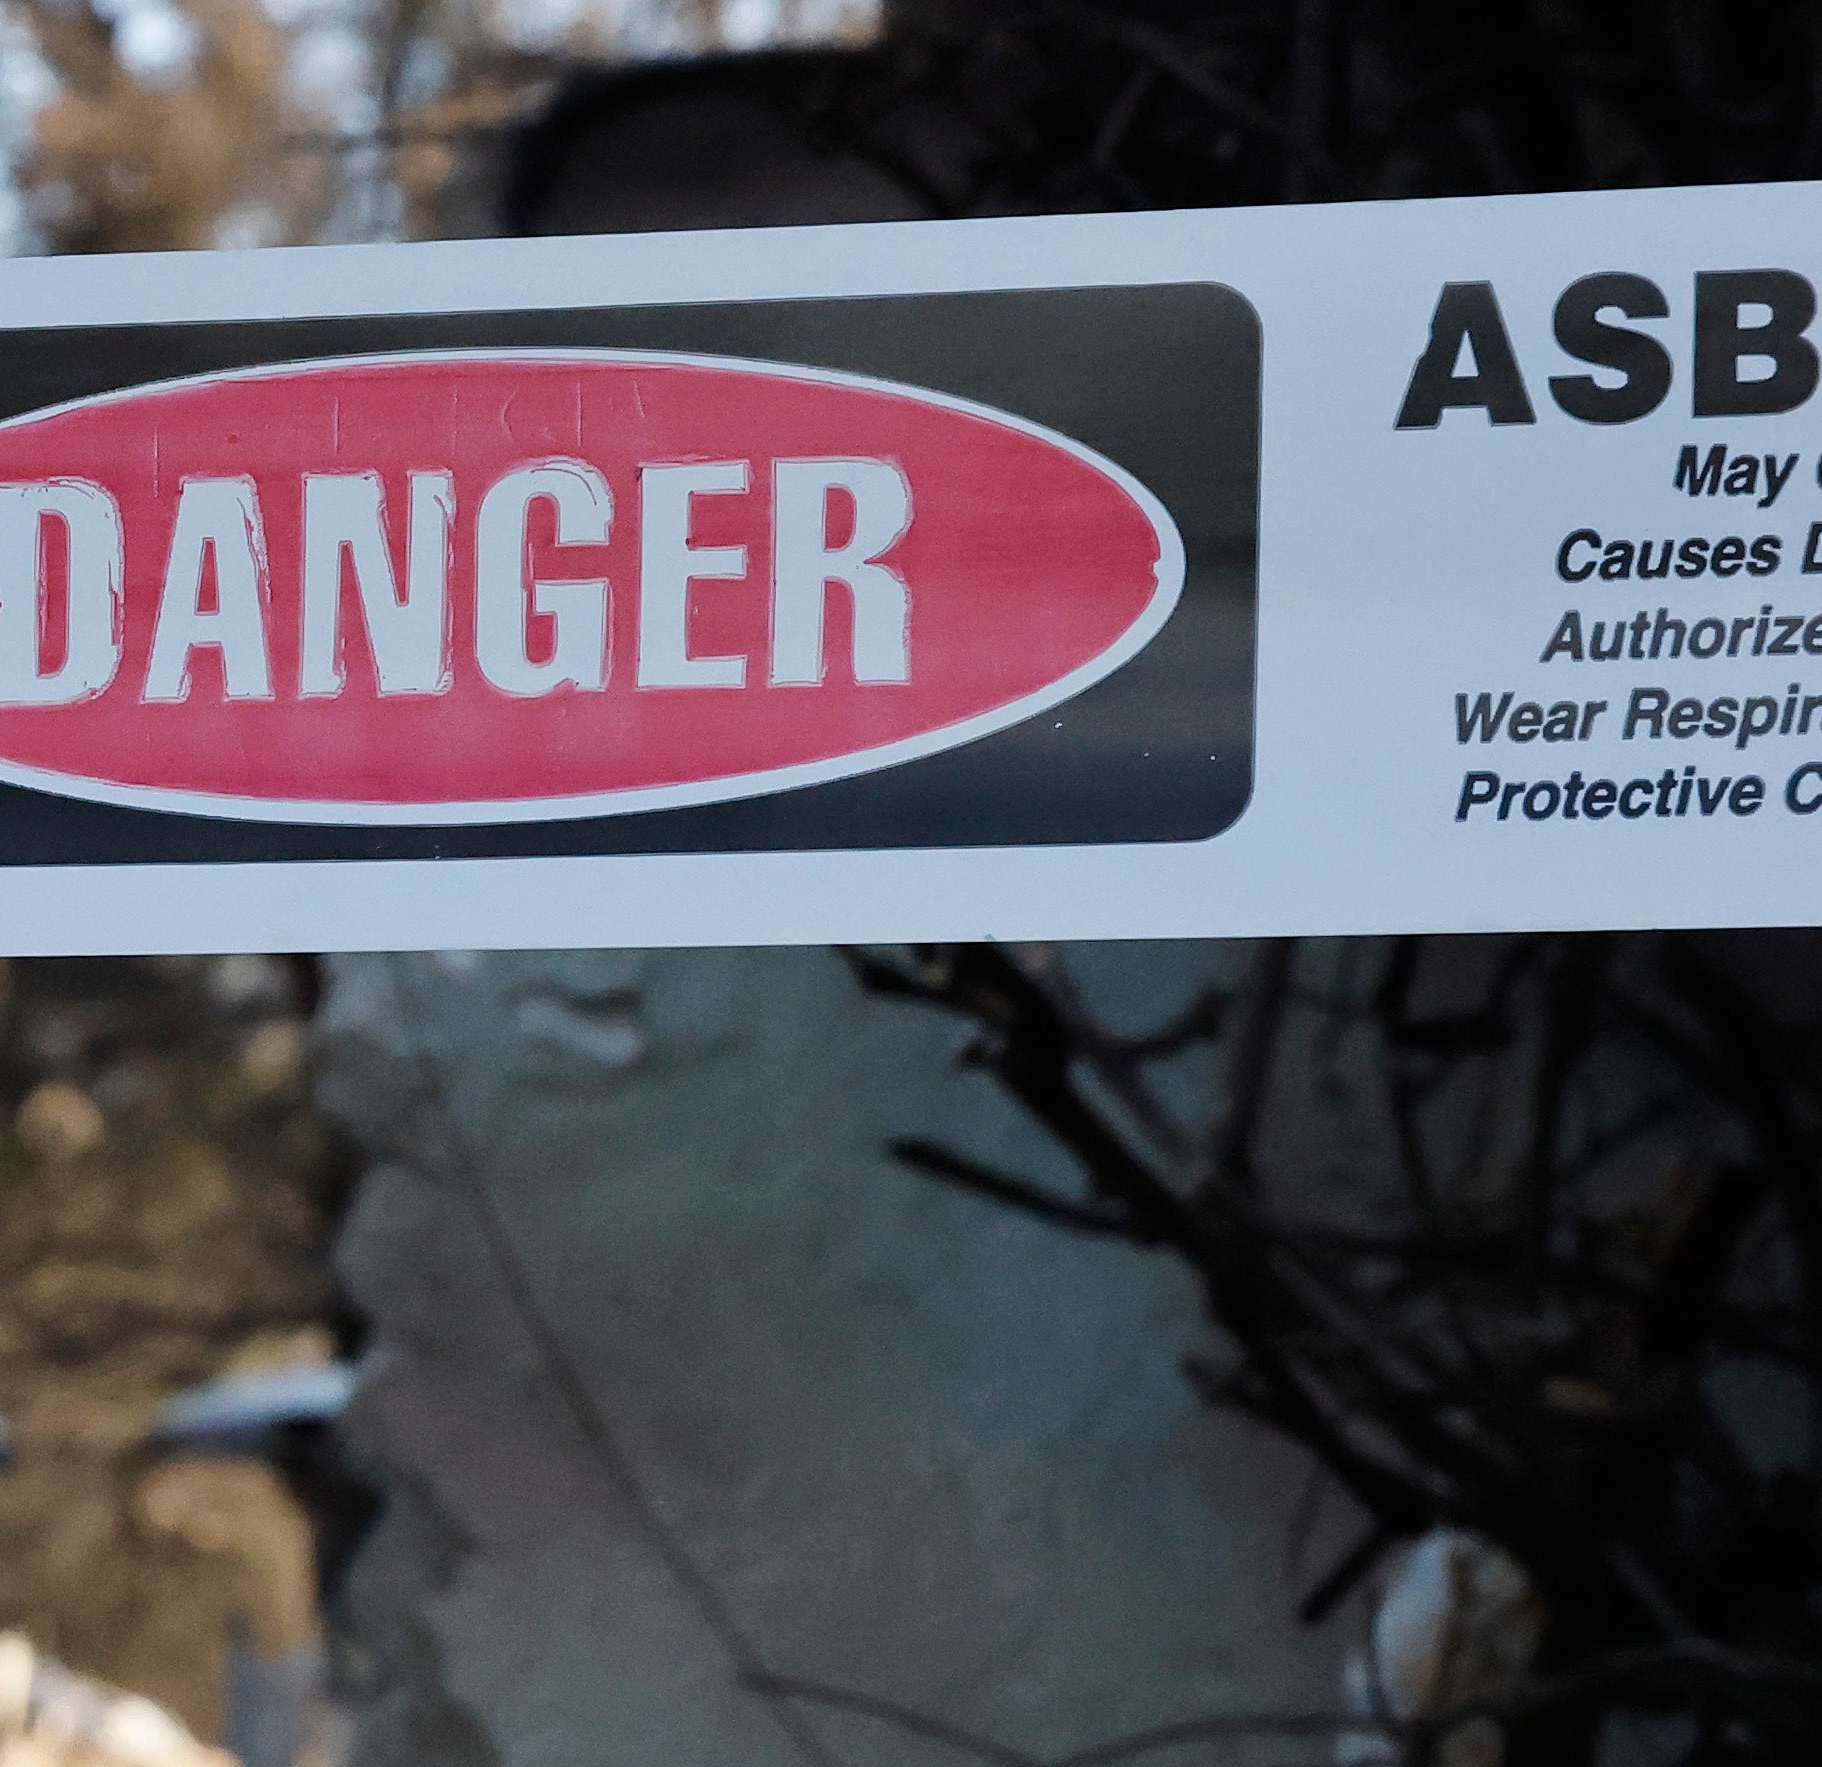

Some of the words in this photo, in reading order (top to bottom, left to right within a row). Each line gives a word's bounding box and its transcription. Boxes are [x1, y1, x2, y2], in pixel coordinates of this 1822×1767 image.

[1393, 267, 1822, 431] ASB
[1673, 443, 1800, 509] May
[1555, 528, 1783, 584] Causes
[1454, 692, 1612, 745] Wear
[1622, 683, 1822, 750] Respir
[1454, 765, 1767, 823] Protective
